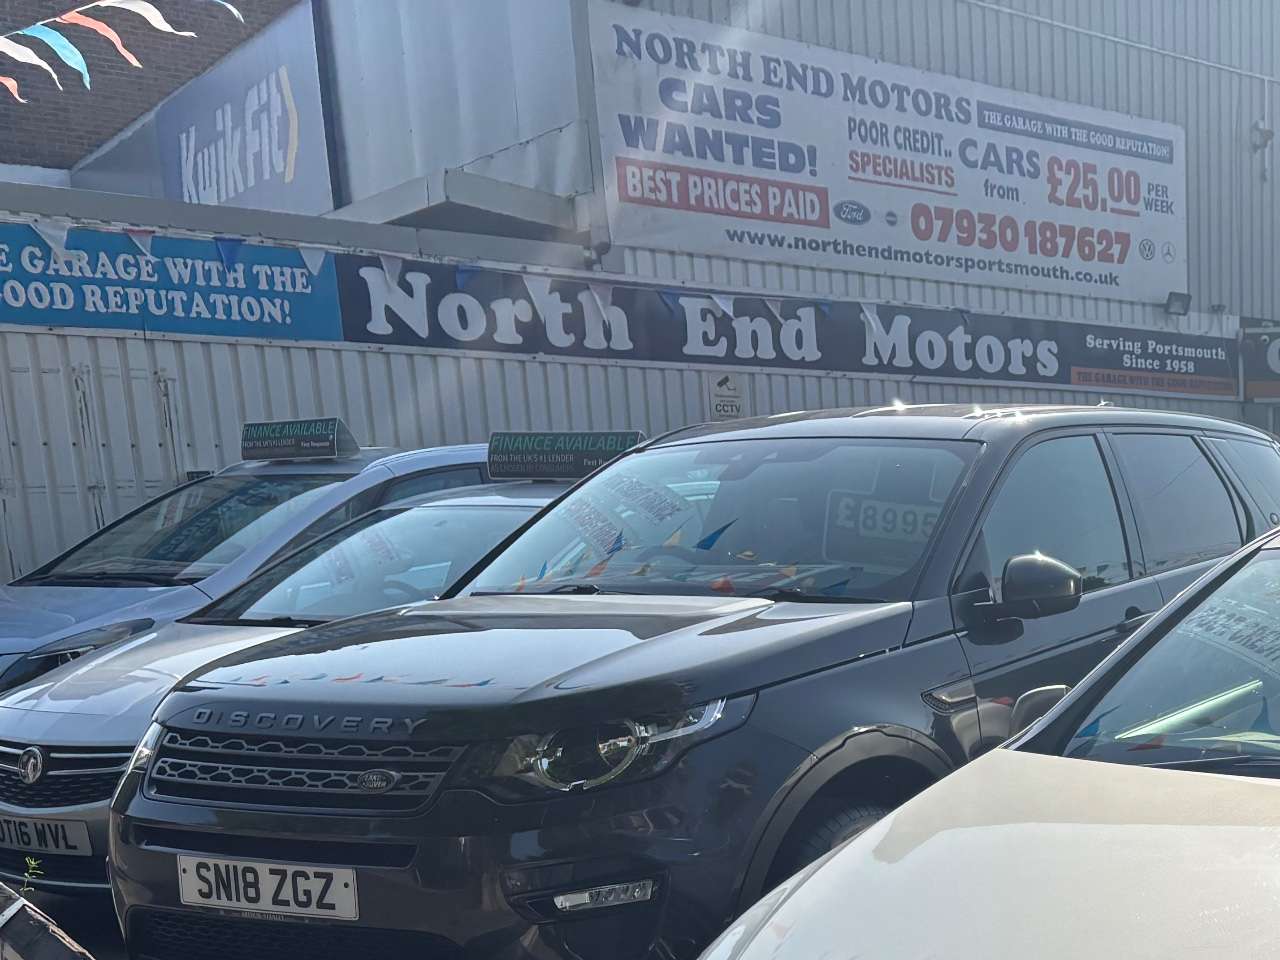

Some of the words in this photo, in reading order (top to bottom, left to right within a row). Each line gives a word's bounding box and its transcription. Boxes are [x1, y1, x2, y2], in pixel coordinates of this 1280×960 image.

[612, 24, 752, 82] NORTH
[760, 55, 834, 98] END
[841, 72, 972, 125] MOTORS
[659, 77, 781, 128] CARS
[618, 113, 817, 177] WANTED!
[848, 116, 889, 147] POOR
[984, 110, 1002, 125] THE
[1004, 114, 1044, 134] GARAGE
[1045, 123, 1068, 138] WITH
[1071, 128, 1088, 142] THE
[1090, 131, 1114, 147] GOOD
[849, 150, 955, 188] SPECIALISTS
[958, 137, 1041, 179] CARS
[625, 165, 680, 203] BEST
[688, 173, 762, 214] PRICES
[767, 186, 820, 221] PAID
[984, 178, 1019, 202] from
[1047, 155, 1141, 211] £25.00
[1147, 182, 1169, 198] PER
[1143, 198, 1174, 215] WEEK
[910, 202, 1020, 253] 07930
[1024, 220, 1131, 265] 187627
[20, 245, 158, 282] GARAGE
[164, 257, 246, 289] WITH
[252, 264, 312, 294] THE
[726, 228, 1120, 287] www.northendmotorsportsmouth.co.uk
[0, 279, 74, 310] OOD
[80, 284, 293, 325] REPUTATION!
[358, 265, 634, 351] North
[679, 297, 822, 363] End
[860, 313, 1059, 377] Motors
[1086, 334, 1142, 355] Serving
[1147, 340, 1226, 360] Portsmouth
[1123, 354, 1160, 370] Since
[1166, 359, 1195, 373] 1958
[715, 403, 741, 413] CCTV
[490, 435, 552, 451] FINANCE
[554, 435, 636, 452] AVAILABLE
[193, 708, 429, 735] DISCOVERY
[33, 822, 77, 849] WVL
[195, 861, 260, 902] SN18
[269, 867, 336, 911] ZGZ
